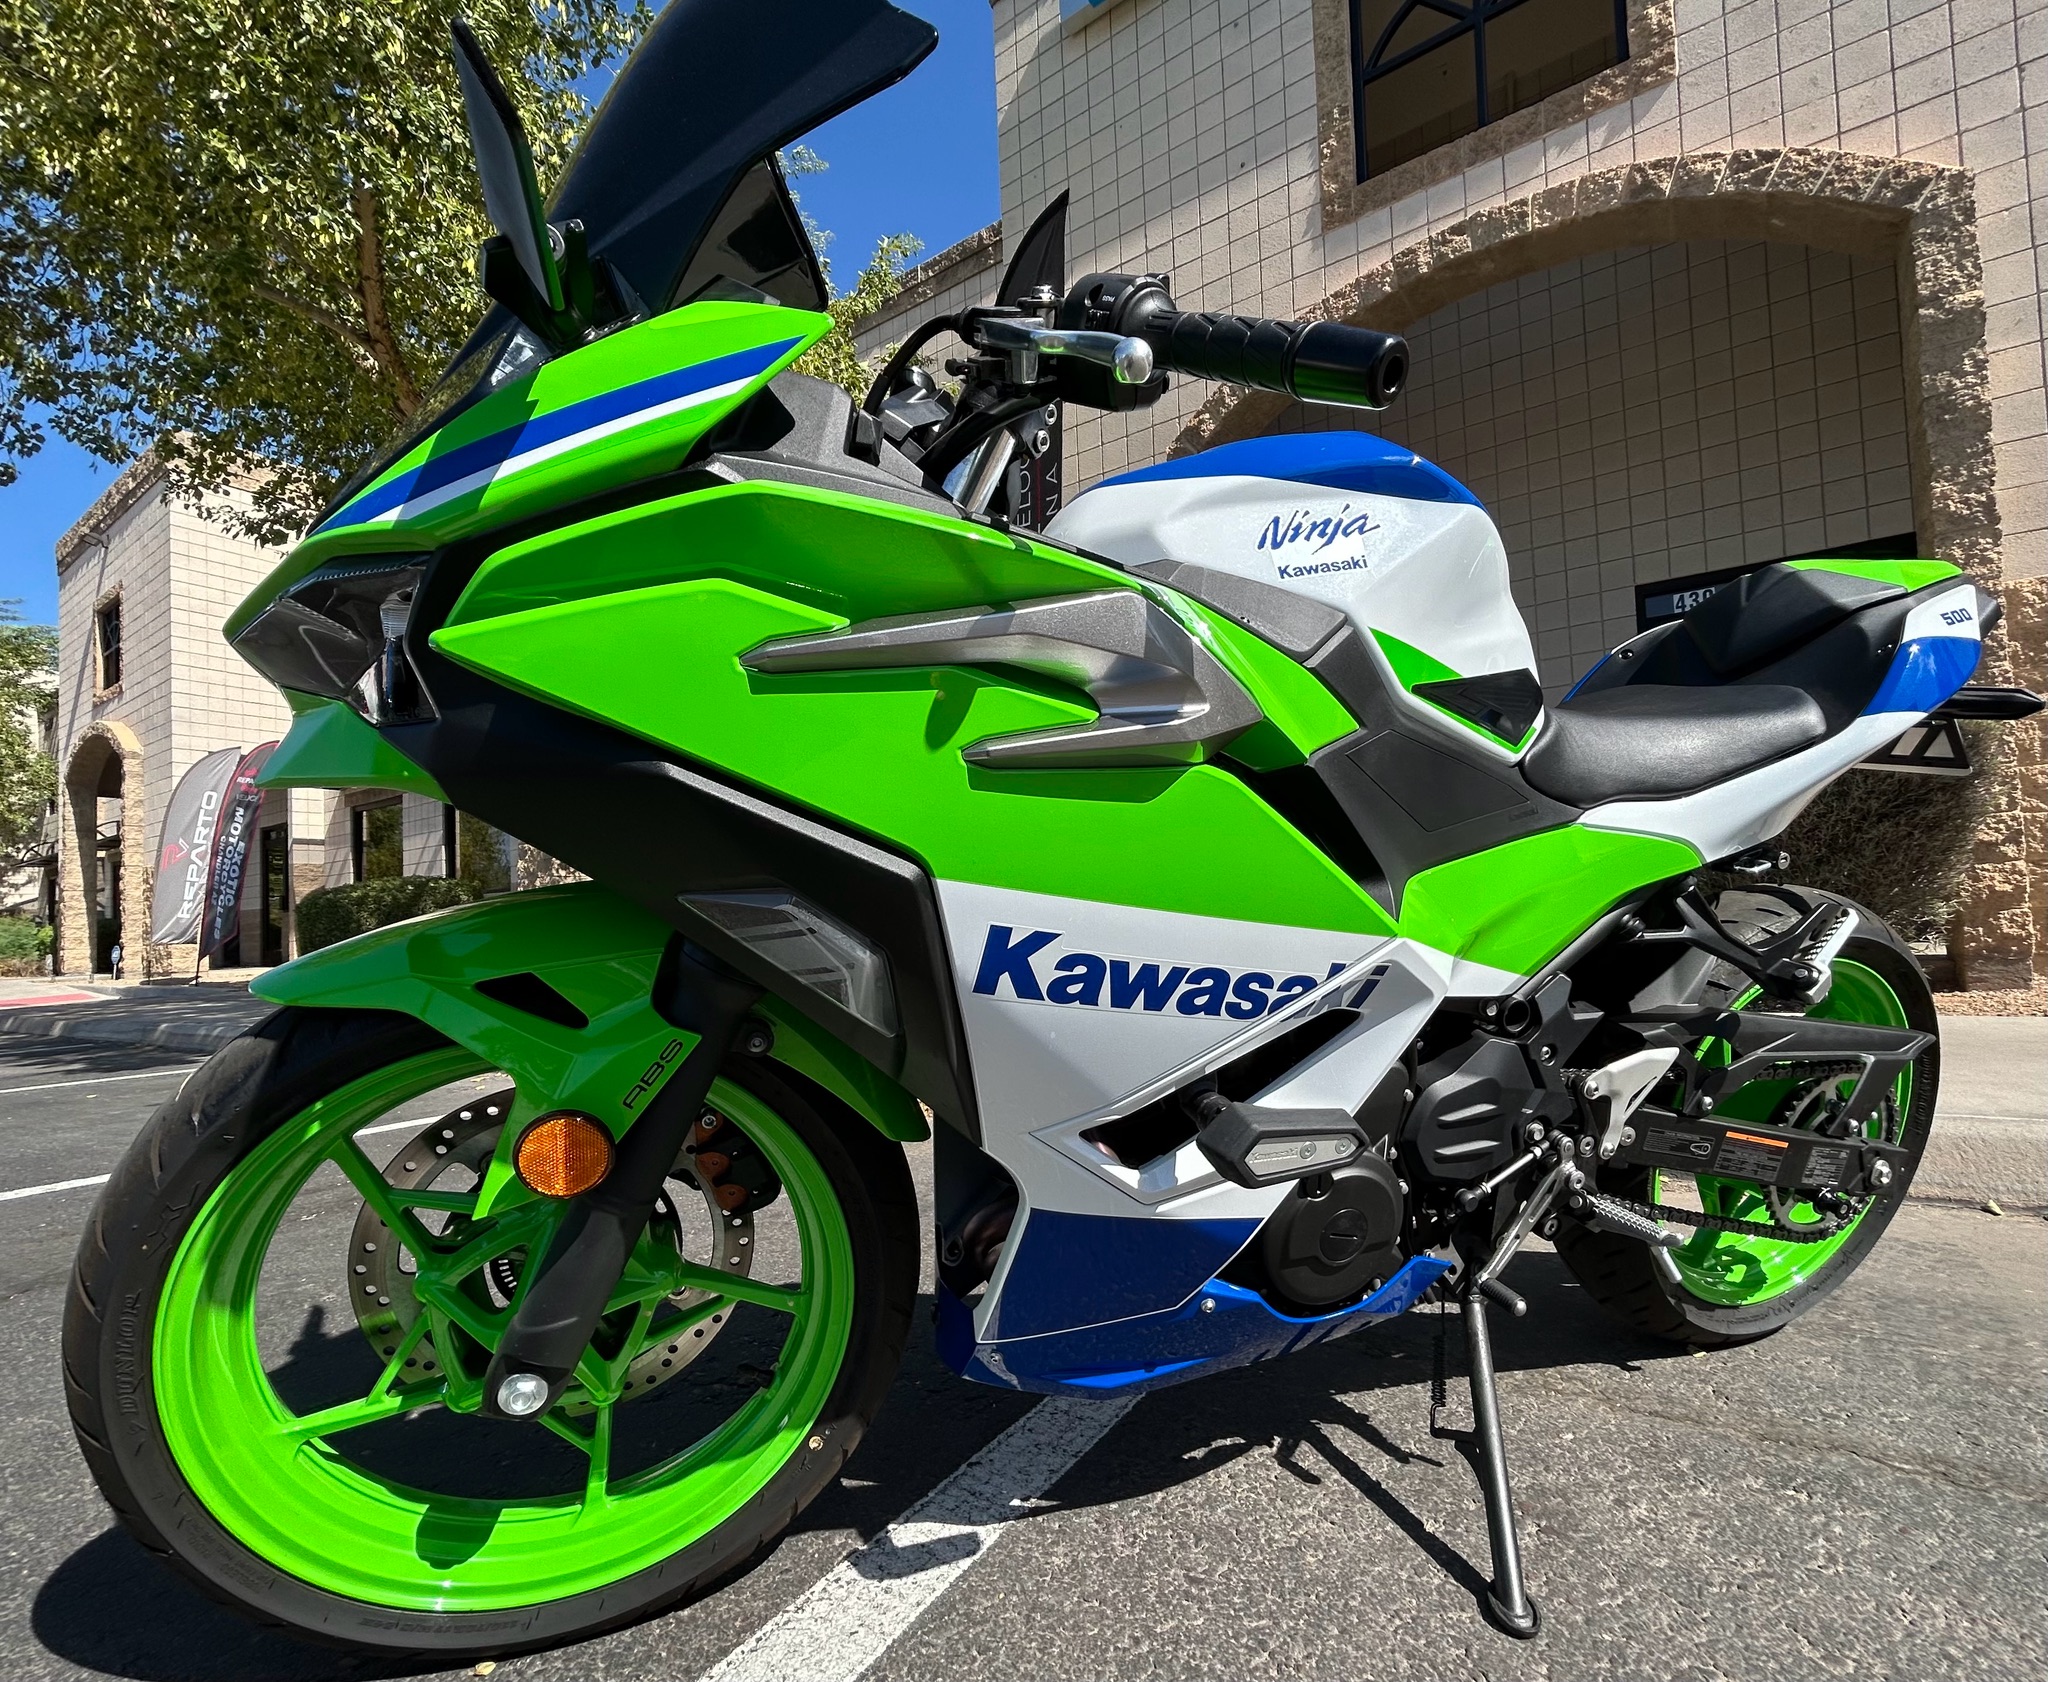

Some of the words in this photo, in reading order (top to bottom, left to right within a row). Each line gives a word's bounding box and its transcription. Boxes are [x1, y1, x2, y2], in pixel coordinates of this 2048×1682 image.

[1257, 503, 1381, 555] Ninja
[1277, 554, 1369, 580] Kawasaki
[1940, 608, 1973, 626] 500
[177, 790, 218, 920] REPARTO
[213, 806, 245, 940] MOTORCYCLES
[224, 840, 246, 907] EXOTIC
[972, 924, 1392, 1022] Kawasaki
[622, 1038, 684, 1111] ABS
